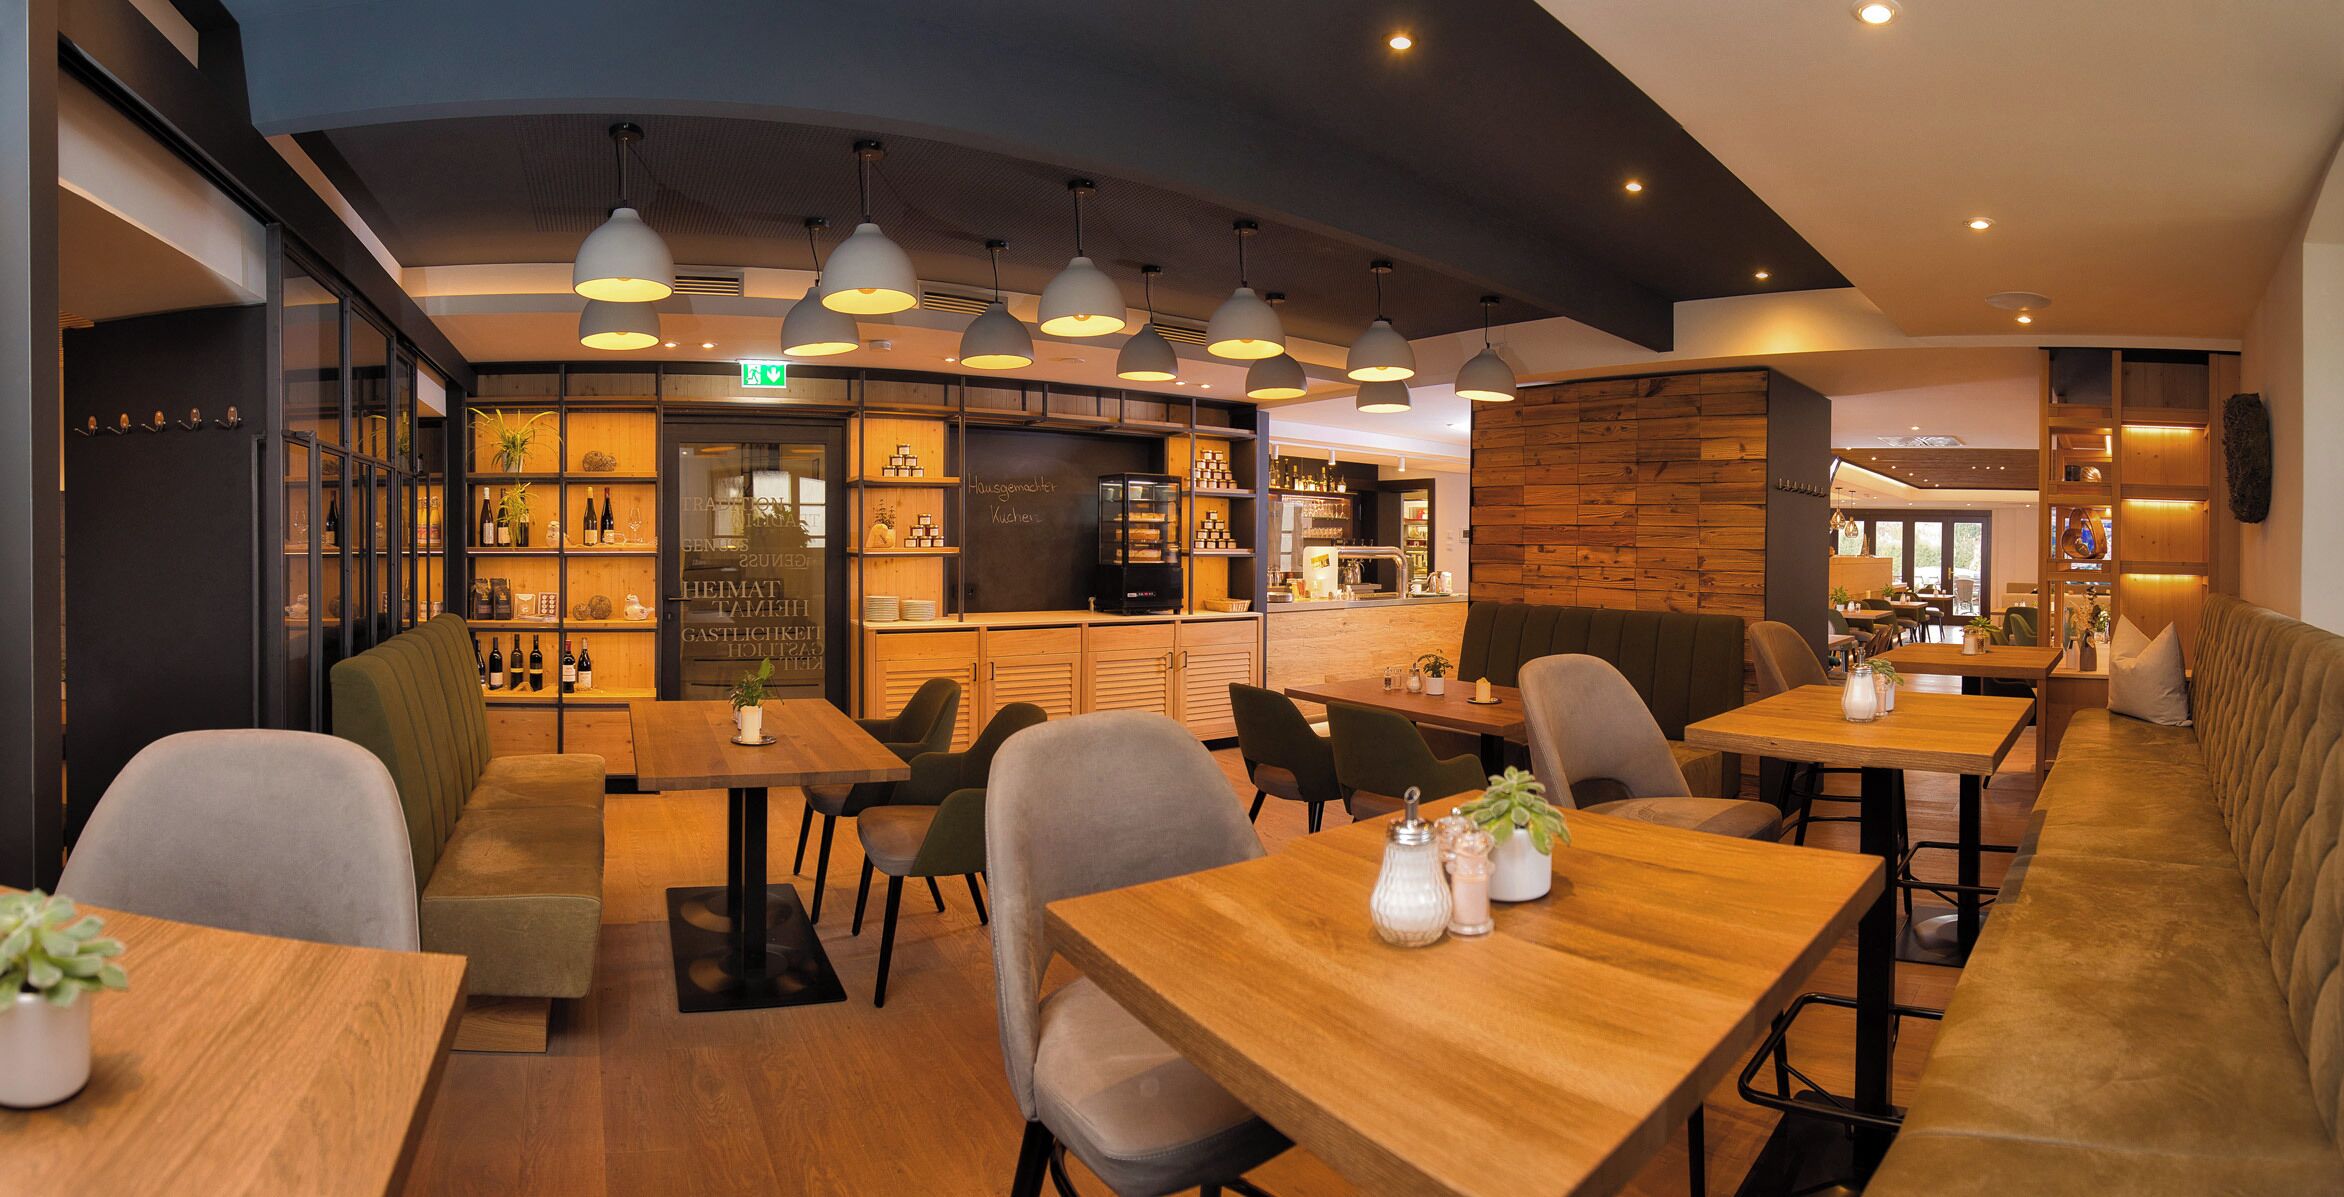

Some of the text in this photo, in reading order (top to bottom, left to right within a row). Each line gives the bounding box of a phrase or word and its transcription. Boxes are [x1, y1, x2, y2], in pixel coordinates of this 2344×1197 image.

[968, 472, 1057, 502] Hausgemachter
[682, 497, 784, 512] TRADITION
[682, 538, 749, 552] GENUSS
[683, 581, 781, 598] HEIMAT
[682, 627, 823, 642] GASTLICHKEIT
